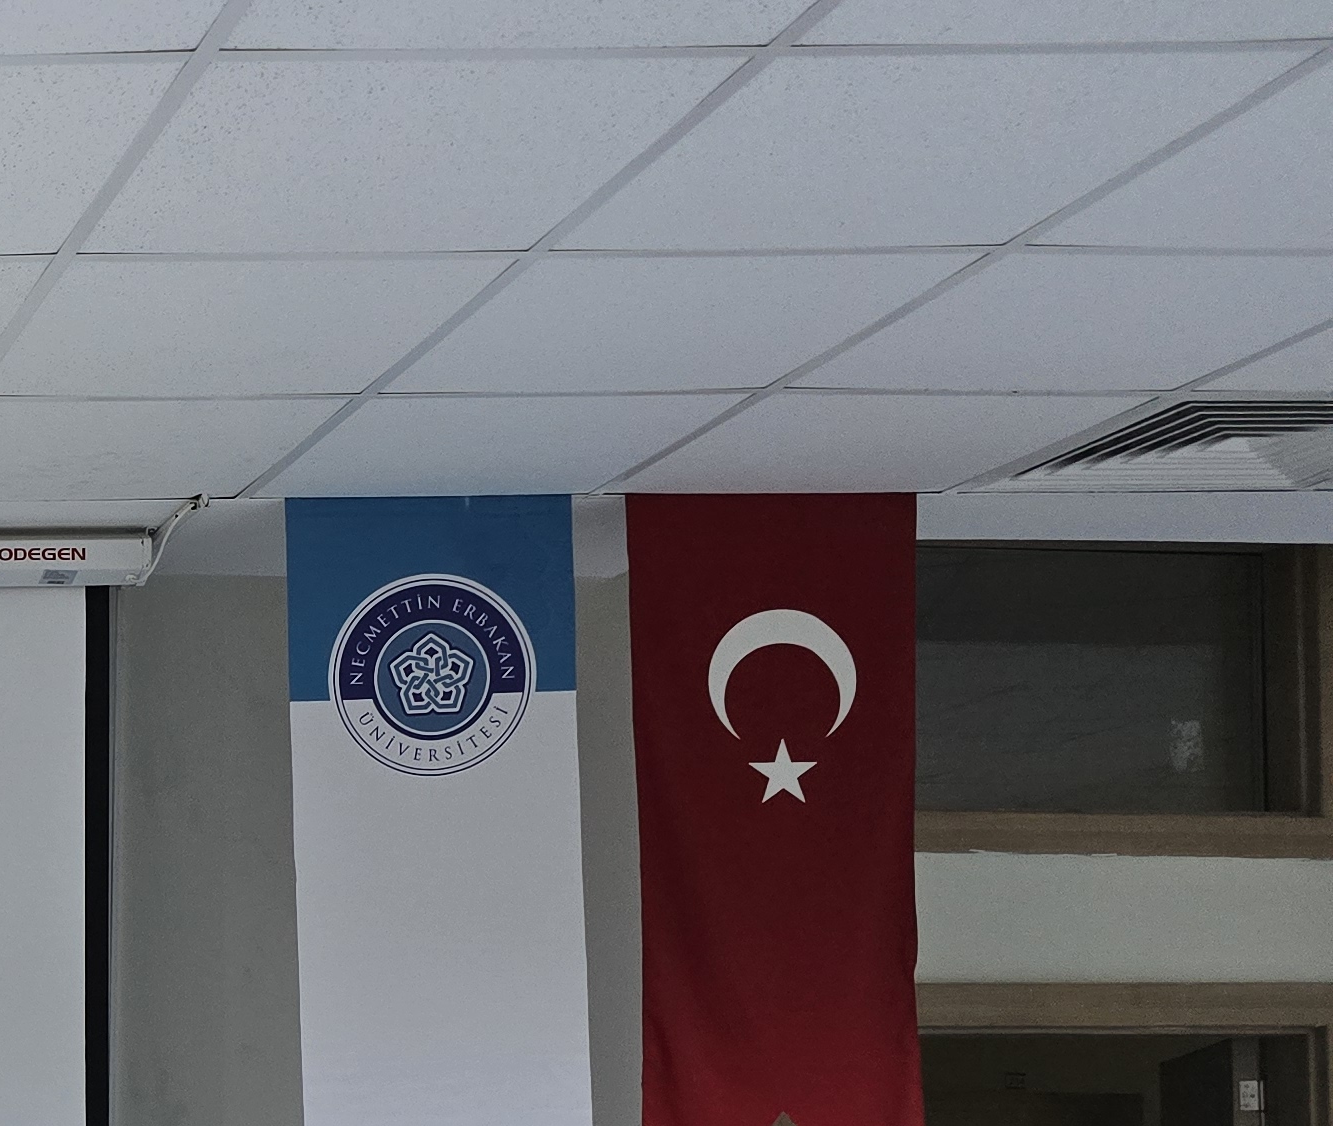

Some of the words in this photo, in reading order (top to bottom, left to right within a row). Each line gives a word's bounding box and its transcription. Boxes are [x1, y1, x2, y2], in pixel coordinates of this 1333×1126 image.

[349, 593, 441, 685] NECMETTİN
[452, 598, 515, 680] ERBAKAN
[359, 705, 508, 762] ÜNİVERSİTESİ
